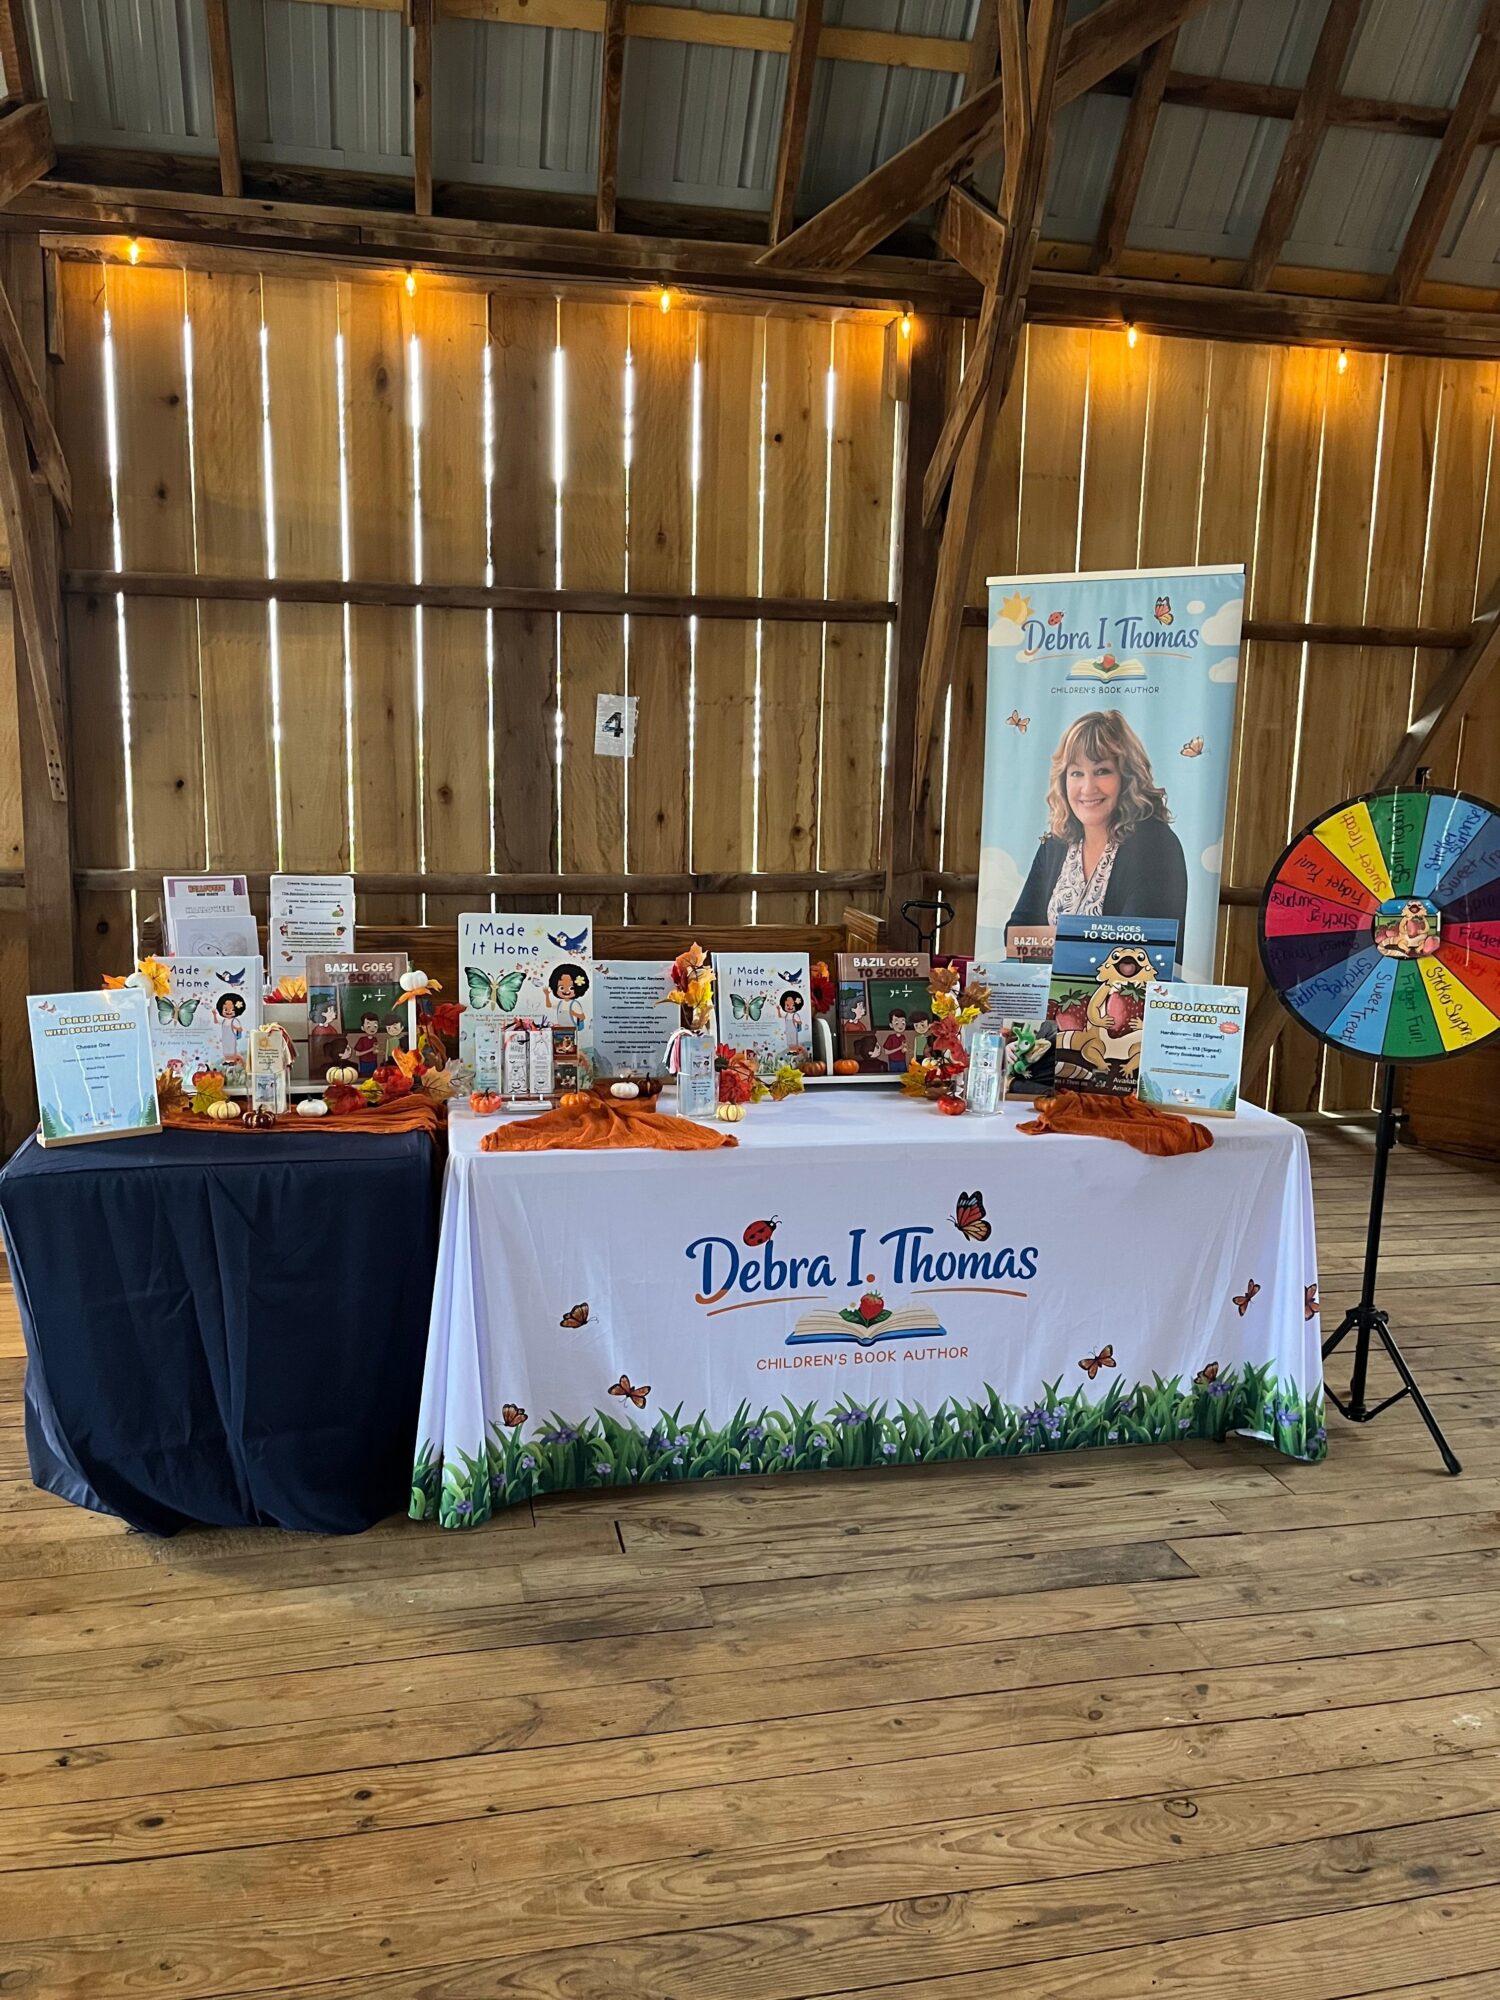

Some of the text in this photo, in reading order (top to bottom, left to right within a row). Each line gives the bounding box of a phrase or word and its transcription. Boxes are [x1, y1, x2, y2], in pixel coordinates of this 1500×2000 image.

[1021, 619, 1092, 654] Debra
[1114, 616, 1199, 649] Thomas
[1050, 685, 1160, 695] CHILDREN'S BOOK AUTHOR
[602, 712, 623, 737] 4
[1339, 811, 1387, 893] Sweet Treat!
[1424, 832, 1457, 871] Sticker
[1293, 854, 1365, 905] Fidget Fun!
[1439, 859, 1478, 896] Sweet
[1306, 910, 1359, 930] Sticker
[465, 922, 525, 936] I Made
[1091, 924, 1141, 933] BAZIL GOES
[1013, 936, 1039, 946] BAZIL
[1083, 930, 1148, 942] TO SCHOOL
[472, 942, 539, 956] It Home
[1017, 946, 1053, 957] TO SCHO
[324, 962, 394, 973] BAZIL GOES
[853, 957, 919, 967] BAZIL GOES
[1444, 947, 1487, 978] Sweet
[329, 973, 393, 982] TO SCHOOL
[729, 966, 765, 976] I Made
[858, 967, 919, 978] TO SCHOOL
[176, 979, 210, 988] Home
[733, 978, 774, 987] It Home
[1327, 957, 1373, 1000] Sticker
[1367, 971, 1393, 1014] Sweet
[1426, 966, 1453, 1006] Sticker
[1150, 1000, 1240, 1014] BOOKS & FESTIVAL
[1400, 972, 1425, 1045] Fidget Fun!
[1170, 1013, 1217, 1024] SPECIALS
[44, 1028, 68, 1037] WITH
[69, 1026, 93, 1035] BOOK
[685, 1226, 1039, 1305] Debra I. Thomas
[756, 1346, 969, 1370] CHILDREN'S BOOK AUTHOR
